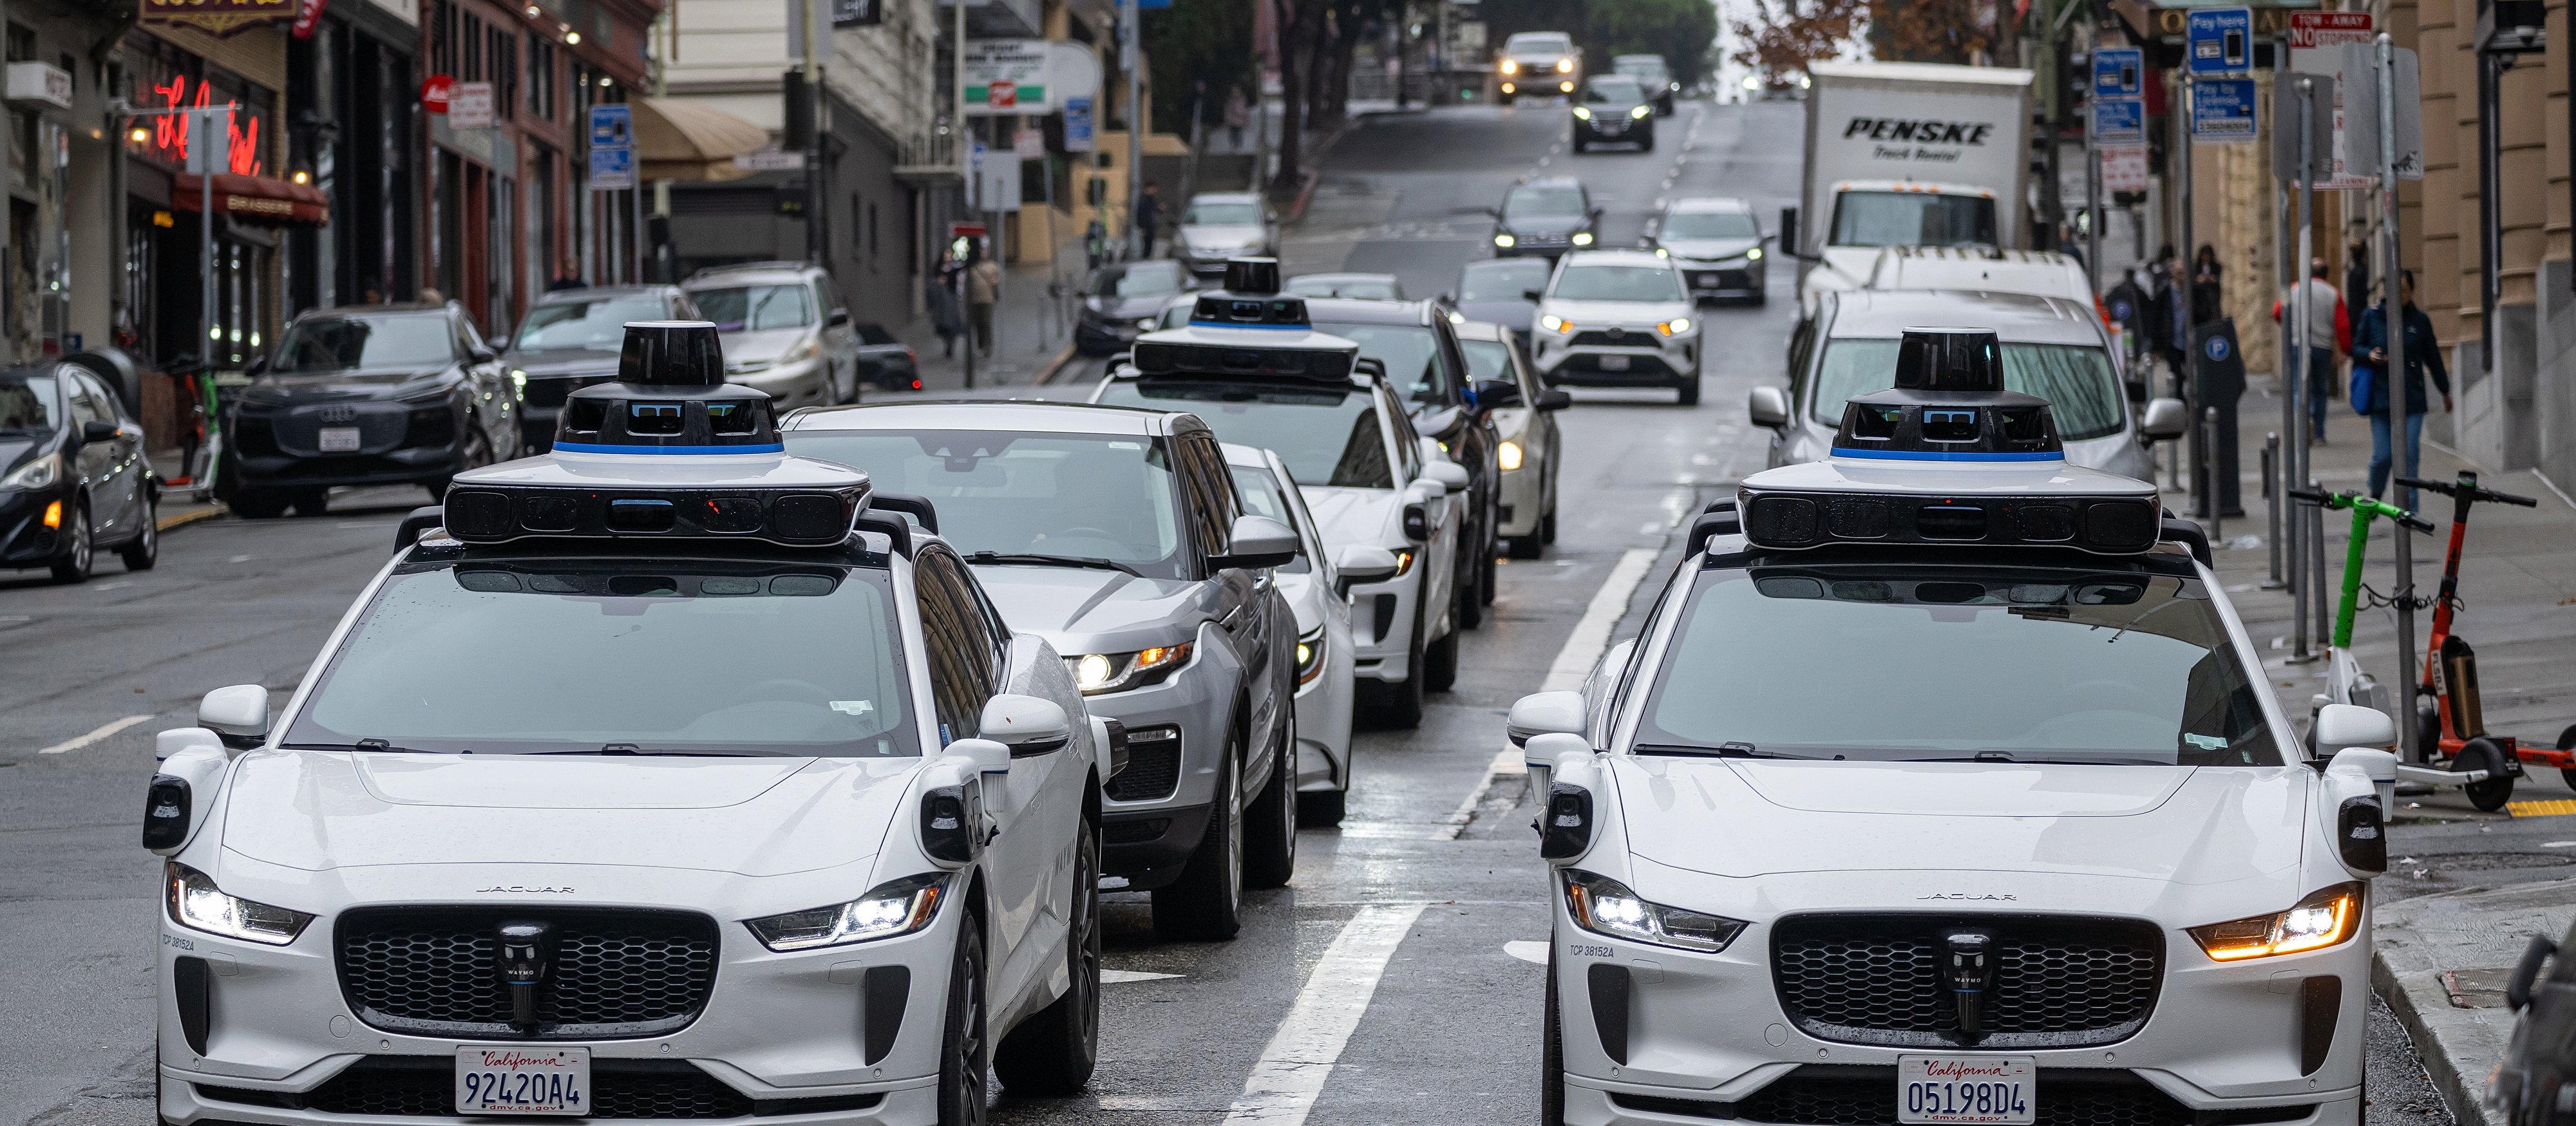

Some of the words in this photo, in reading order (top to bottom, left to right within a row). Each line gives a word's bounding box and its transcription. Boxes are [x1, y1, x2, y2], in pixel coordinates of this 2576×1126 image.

[2191, 16, 2215, 31] Pay
[2217, 15, 2247, 27] here
[2298, 15, 2322, 26] TOW
[2331, 15, 2365, 26] AWAY
[2292, 27, 2315, 46] NO
[1842, 117, 1994, 147] PENSKE
[1055, 836, 1076, 877] WAYMO
[163, 934, 172, 945] TCP
[171, 937, 194, 952] 38152A
[1570, 944, 1584, 956] TCP
[1584, 945, 1615, 958] 38152A
[484, 1051, 565, 1071] California
[1927, 1060, 2010, 1082] California
[465, 1072, 580, 1105] 92420A4
[1908, 1082, 2026, 1114] 05198D4
